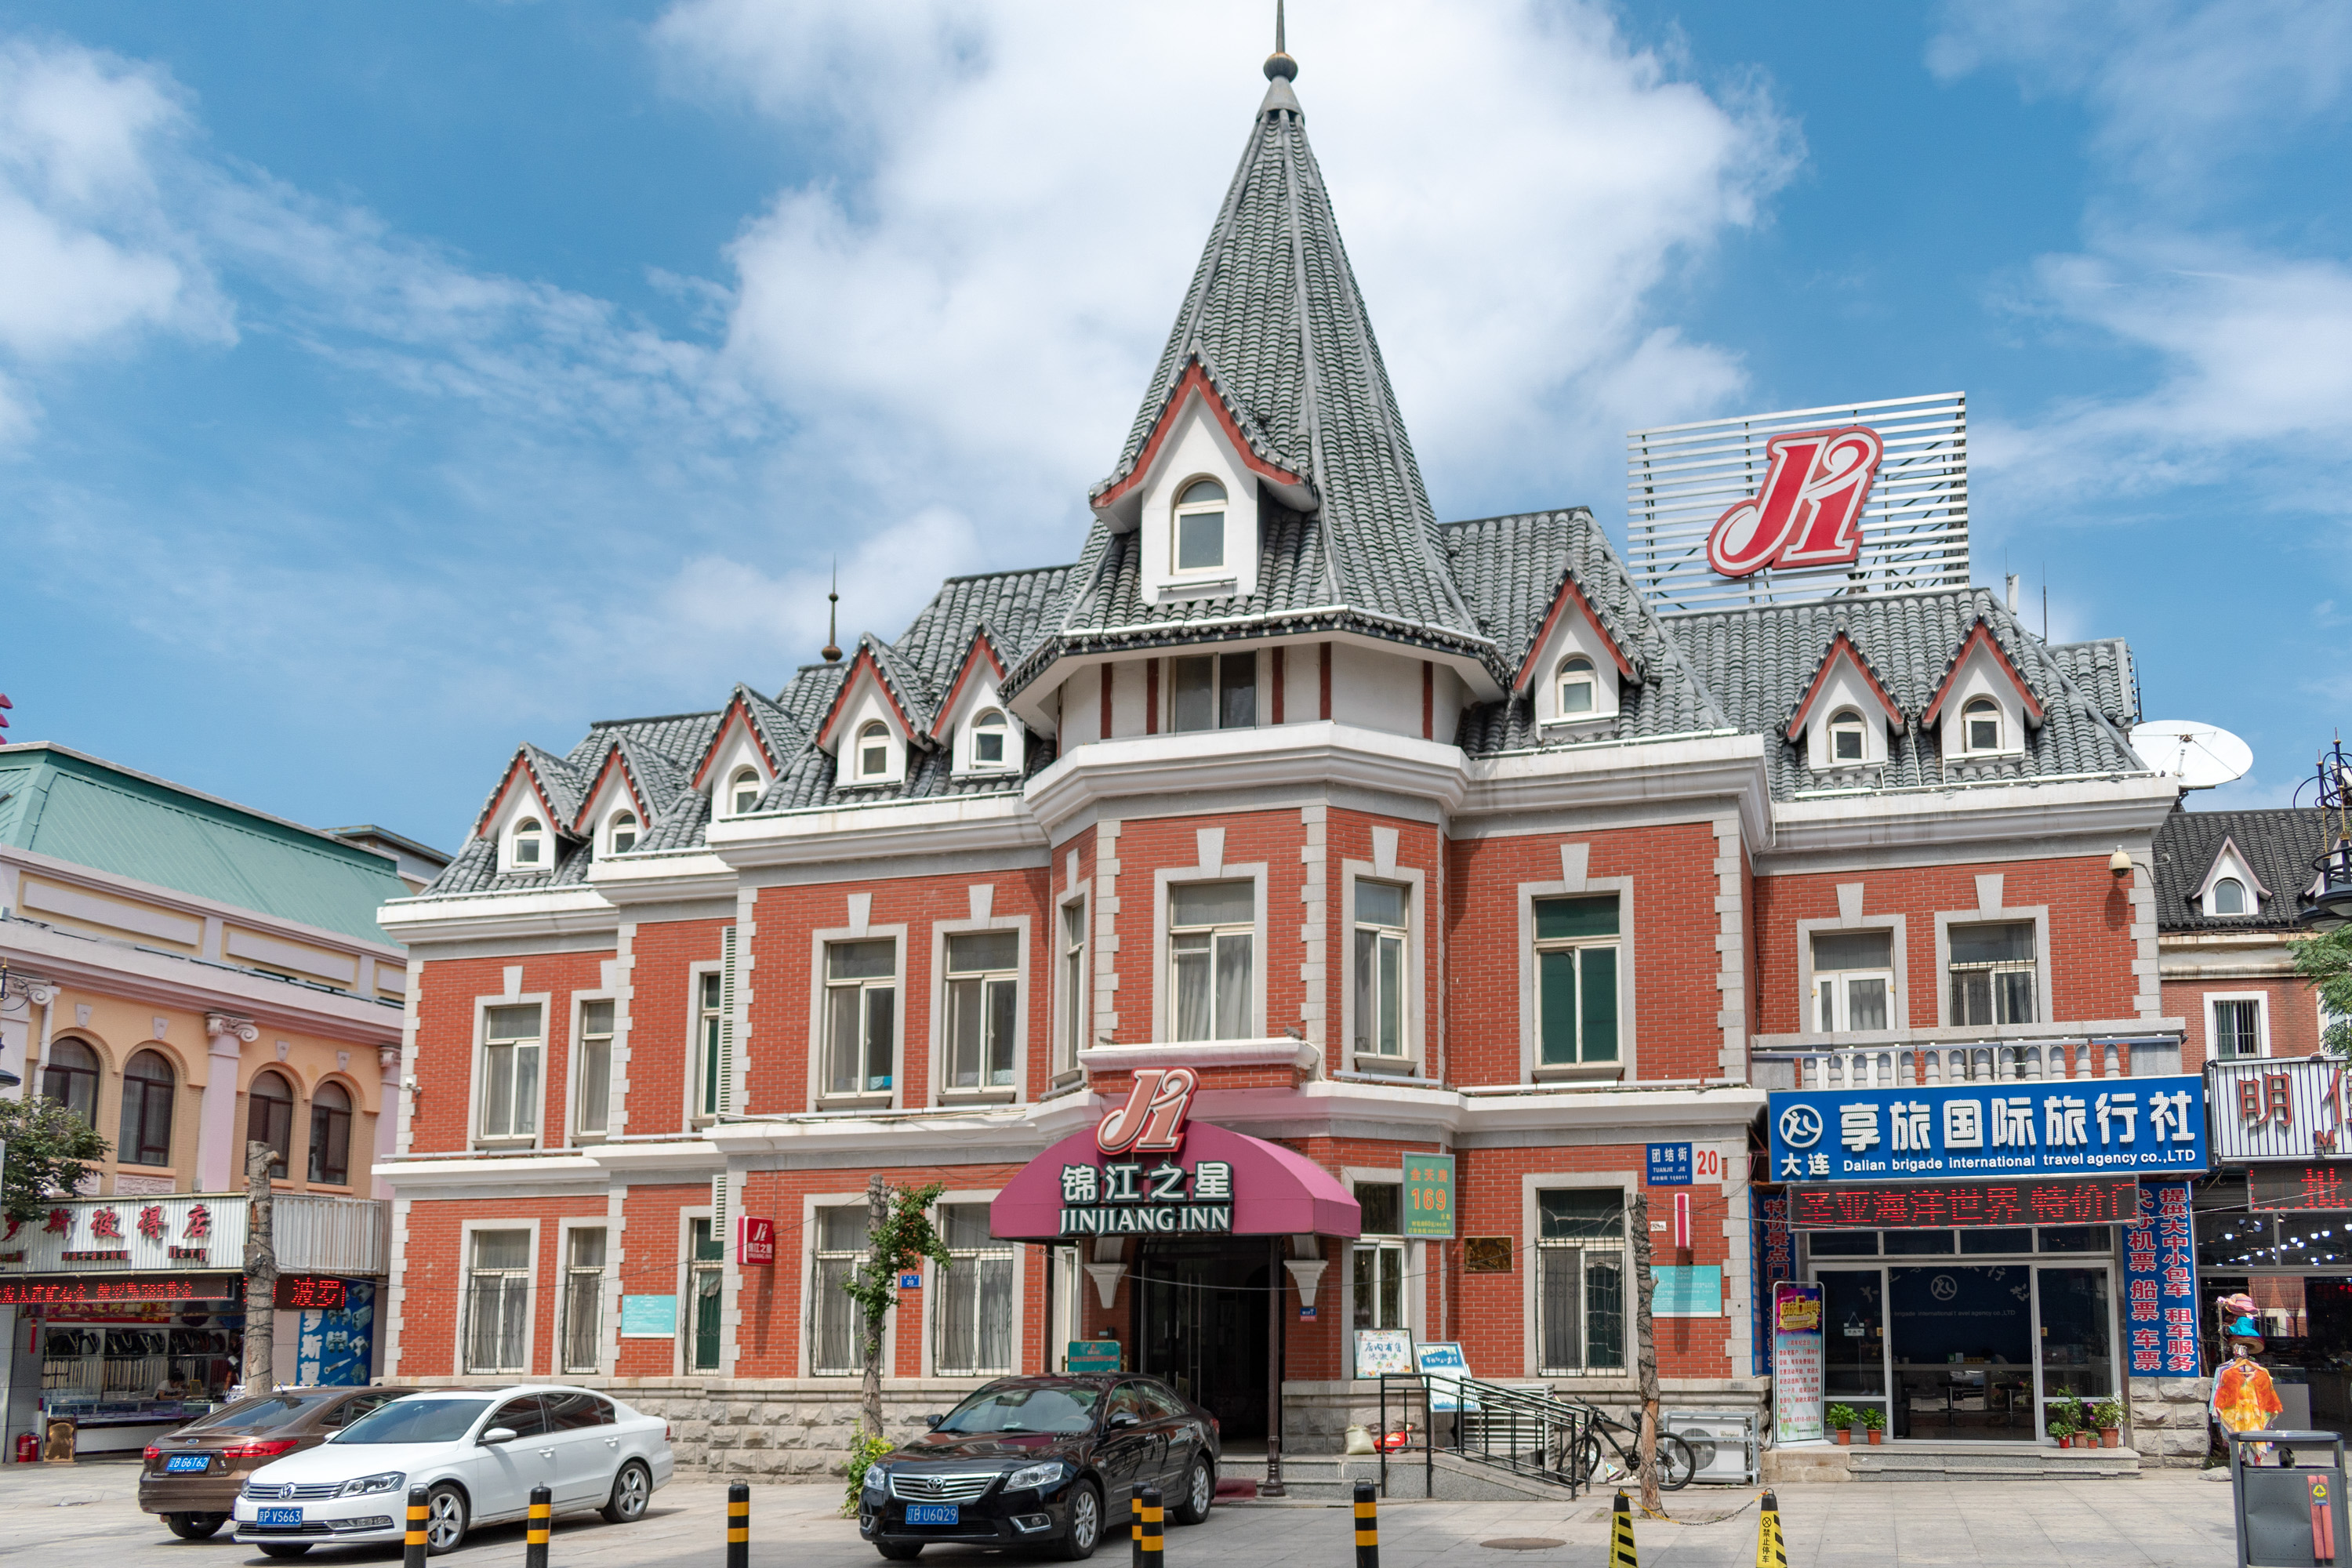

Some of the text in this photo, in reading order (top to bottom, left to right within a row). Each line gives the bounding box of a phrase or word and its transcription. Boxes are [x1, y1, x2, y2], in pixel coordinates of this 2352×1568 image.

[1839, 1091, 2195, 1152] 享旅国际旅行社
[1652, 1147, 1687, 1163] 团结街
[1697, 1150, 1718, 1175] 20
[1780, 1152, 1831, 1176] 大连
[1844, 1149, 2196, 1172] Dalian brigade international travel agency co.,LTD
[1062, 1161, 1232, 1201] 锦江之星
[1410, 1167, 1448, 1182] 全天房
[1412, 1188, 1446, 1210] 169
[1800, 1188, 2021, 1223] 圣亚海洋世界
[1059, 1207, 1230, 1235] JINJIANG INN
[2159, 1188, 2191, 1298] 提供大中小包车
[2131, 1279, 2159, 1321] 船票
[2133, 1328, 2161, 1370] 车票
[2165, 1308, 2196, 1372] 租车服务
